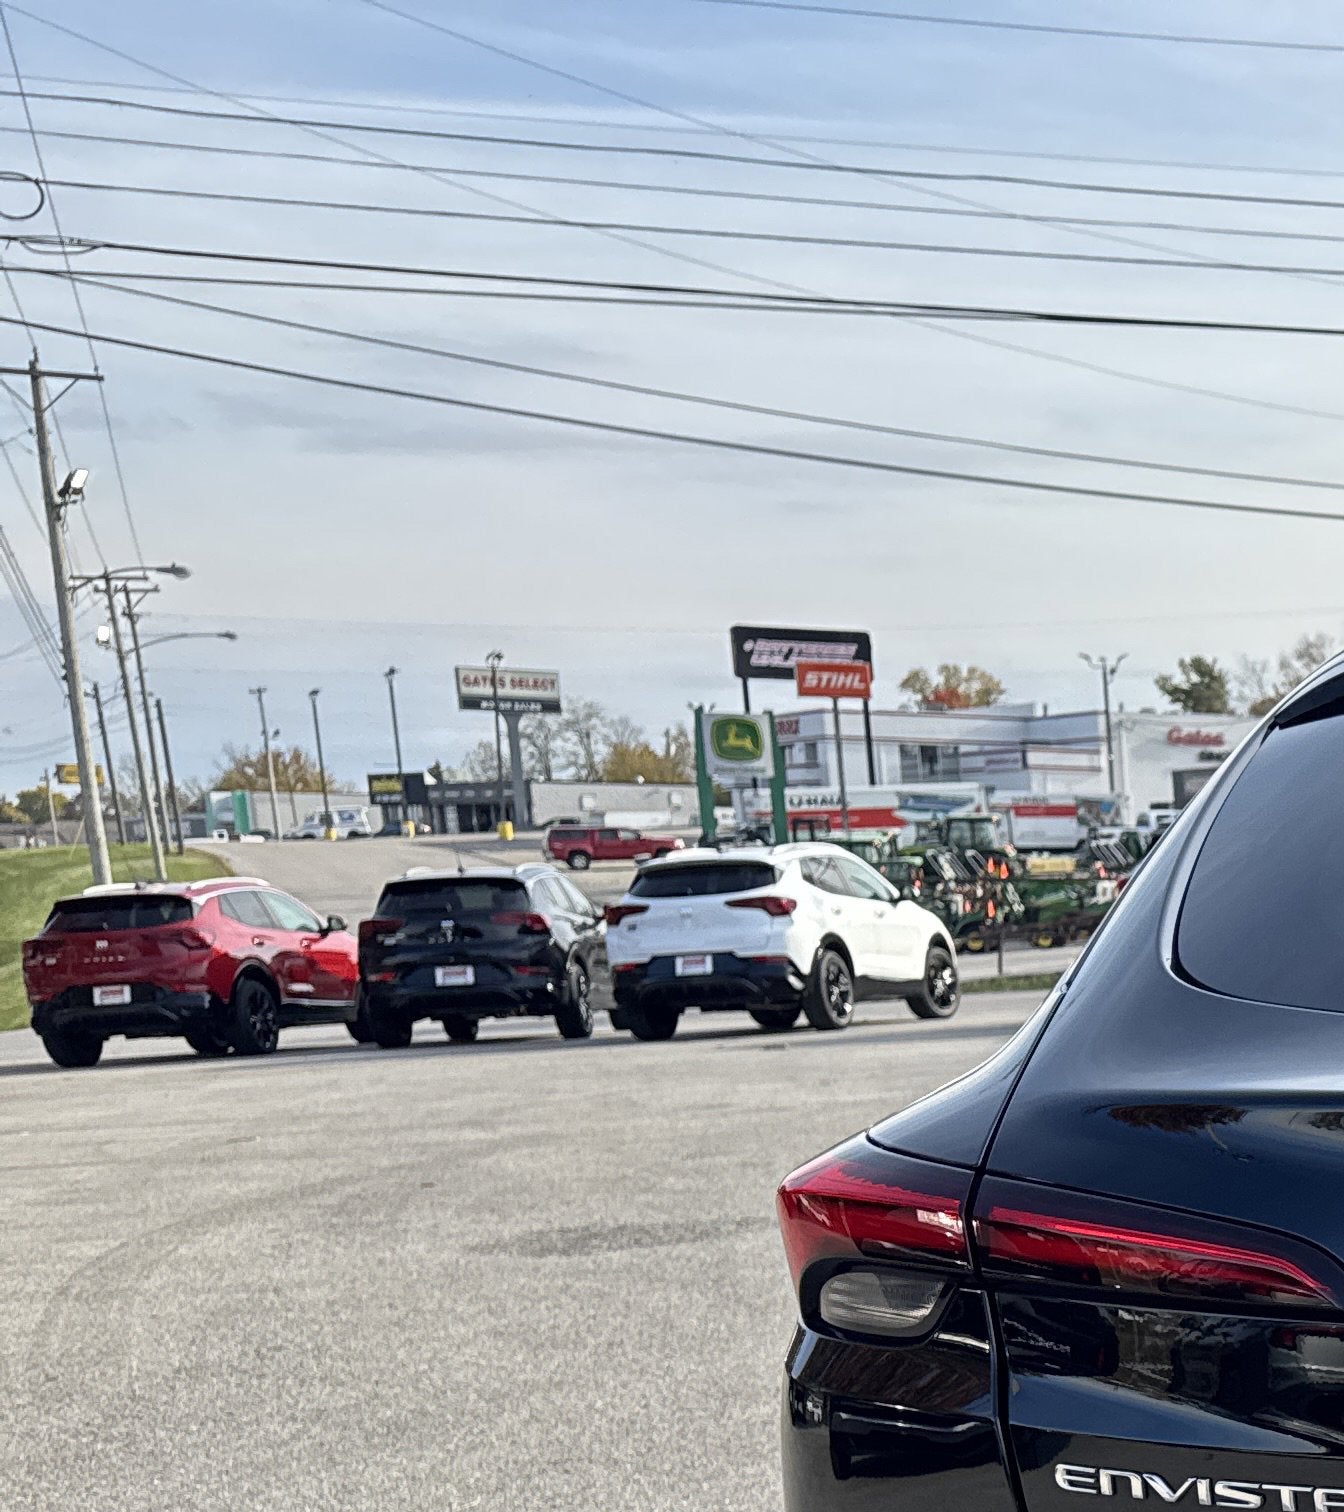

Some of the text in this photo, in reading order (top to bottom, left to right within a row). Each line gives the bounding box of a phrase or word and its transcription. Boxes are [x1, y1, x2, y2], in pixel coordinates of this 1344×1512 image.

[462, 674, 556, 691] GATS SELECT
[803, 671, 866, 689] STIHL
